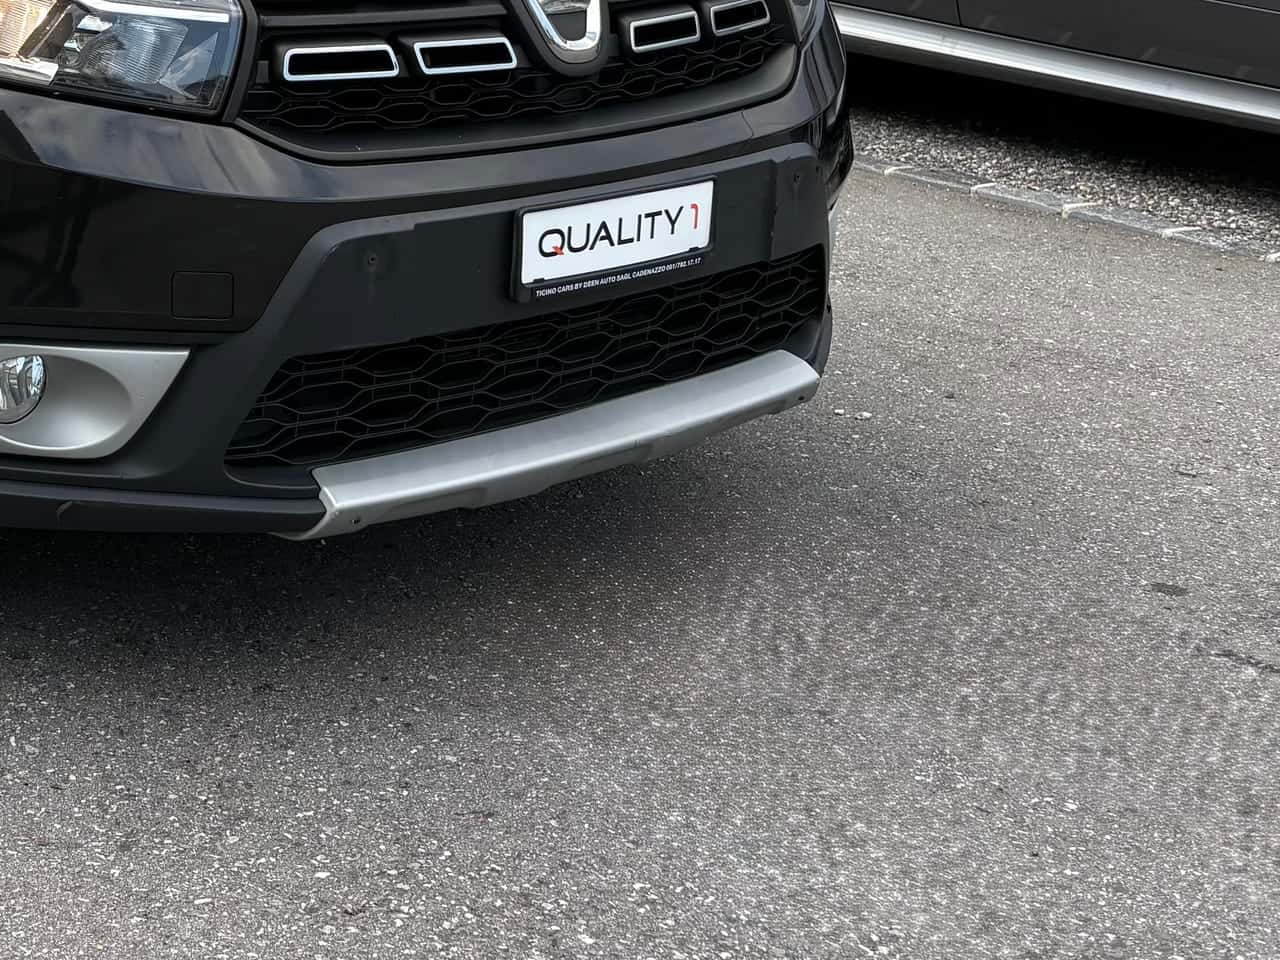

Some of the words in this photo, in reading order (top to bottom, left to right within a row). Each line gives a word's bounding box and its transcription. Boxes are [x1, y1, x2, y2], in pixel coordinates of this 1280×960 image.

[538, 205, 684, 258] QUALITY
[535, 286, 557, 297] TICINO
[557, 284, 574, 294] CARS
[574, 282, 583, 290] BY
[600, 276, 616, 285] AUTO
